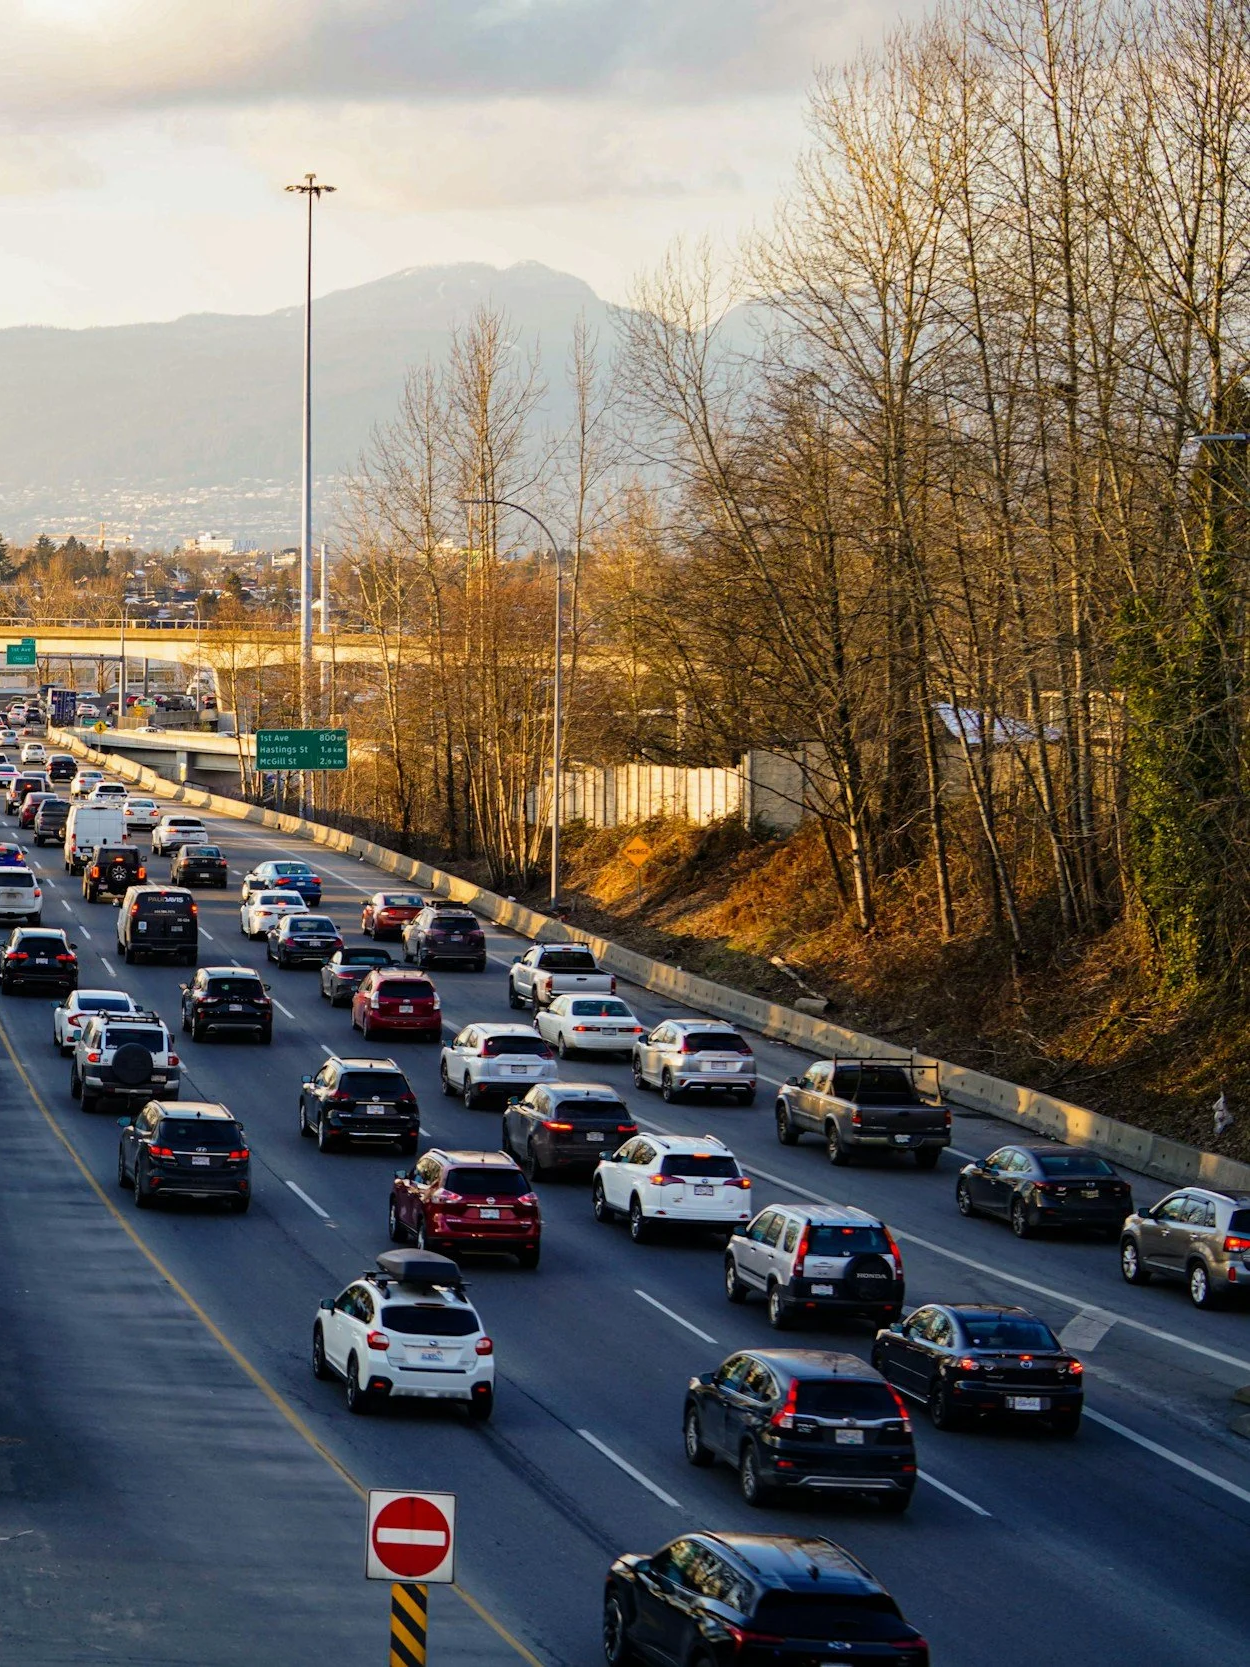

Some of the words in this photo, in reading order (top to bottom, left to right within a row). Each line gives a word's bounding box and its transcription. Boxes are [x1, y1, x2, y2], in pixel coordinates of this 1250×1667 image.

[260, 734, 272, 742] 1st
[274, 734, 289, 742] Ave
[319, 734, 336, 742] 800
[260, 746, 297, 755] Hastings
[260, 757, 286, 765] McGill
[288, 757, 297, 765] St
